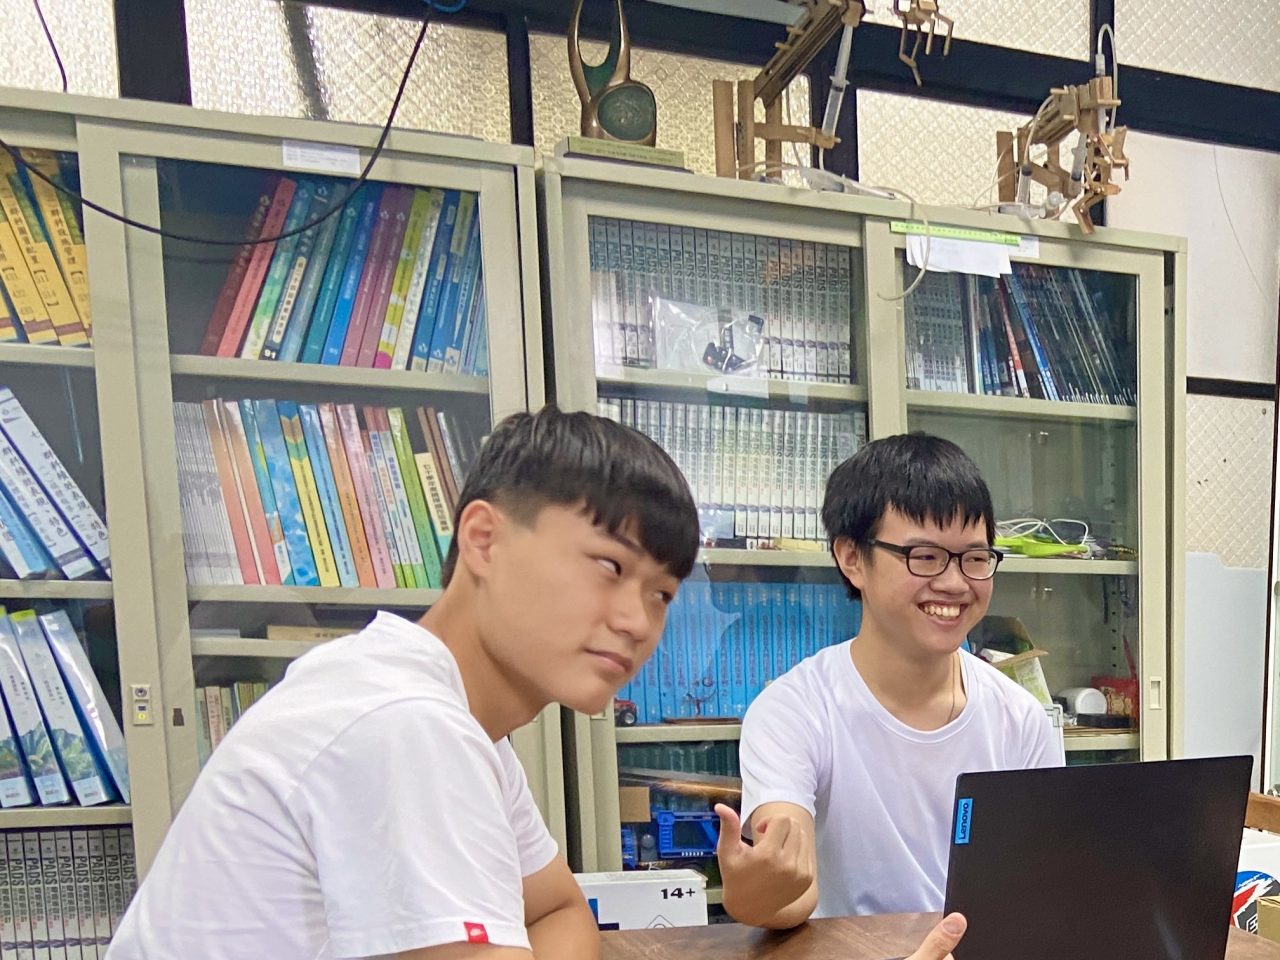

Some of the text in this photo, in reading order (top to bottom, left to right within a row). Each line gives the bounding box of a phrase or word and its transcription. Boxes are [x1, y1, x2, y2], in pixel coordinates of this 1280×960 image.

[958, 802, 969, 840] Lenovo
[9, 859, 25, 887] PADS
[25, 857, 41, 886] PADS
[42, 857, 58, 886] PADS
[58, 855, 74, 884] PADS
[75, 855, 90, 884] PADS
[91, 855, 106, 883] PADS
[105, 854, 121, 882] PADS
[660, 887, 696, 900] 14+
